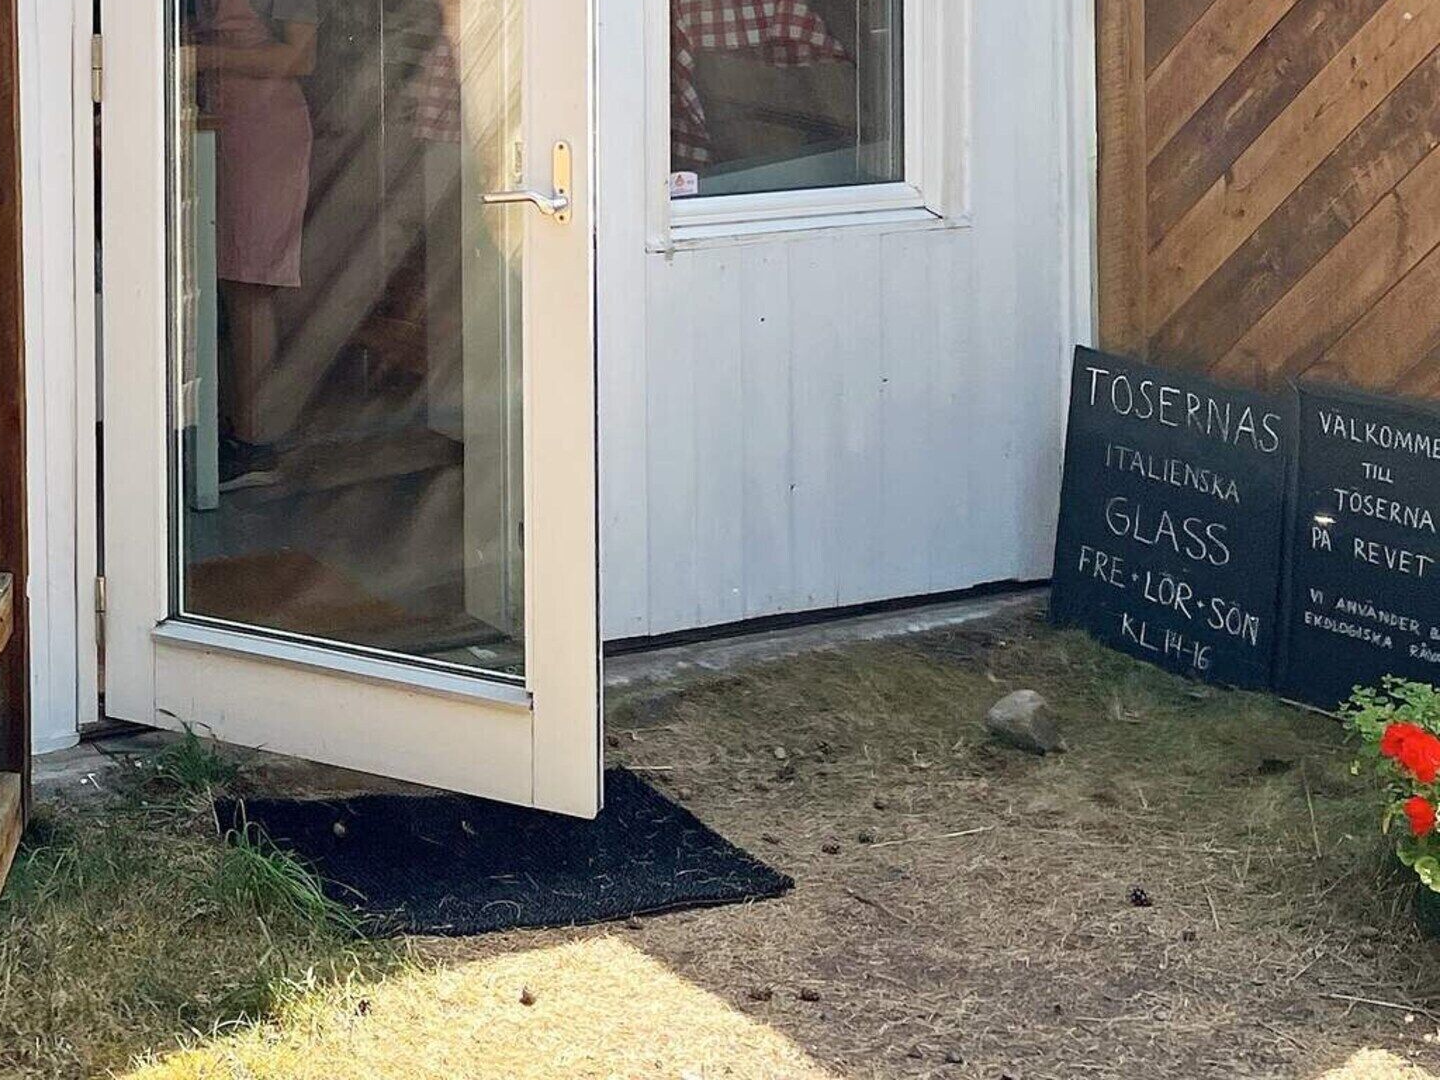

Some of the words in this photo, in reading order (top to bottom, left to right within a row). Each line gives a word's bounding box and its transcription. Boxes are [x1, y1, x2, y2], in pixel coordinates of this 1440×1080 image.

[1106, 443, 1240, 504] ITALIENSKA
[1361, 462, 1394, 484] TILL
[1106, 497, 1230, 566] GLASS
[1354, 537, 1435, 577] REVET
[1310, 587, 1323, 604] VI
[1121, 612, 1159, 651] KL
[1164, 629, 1211, 669] 14-16
